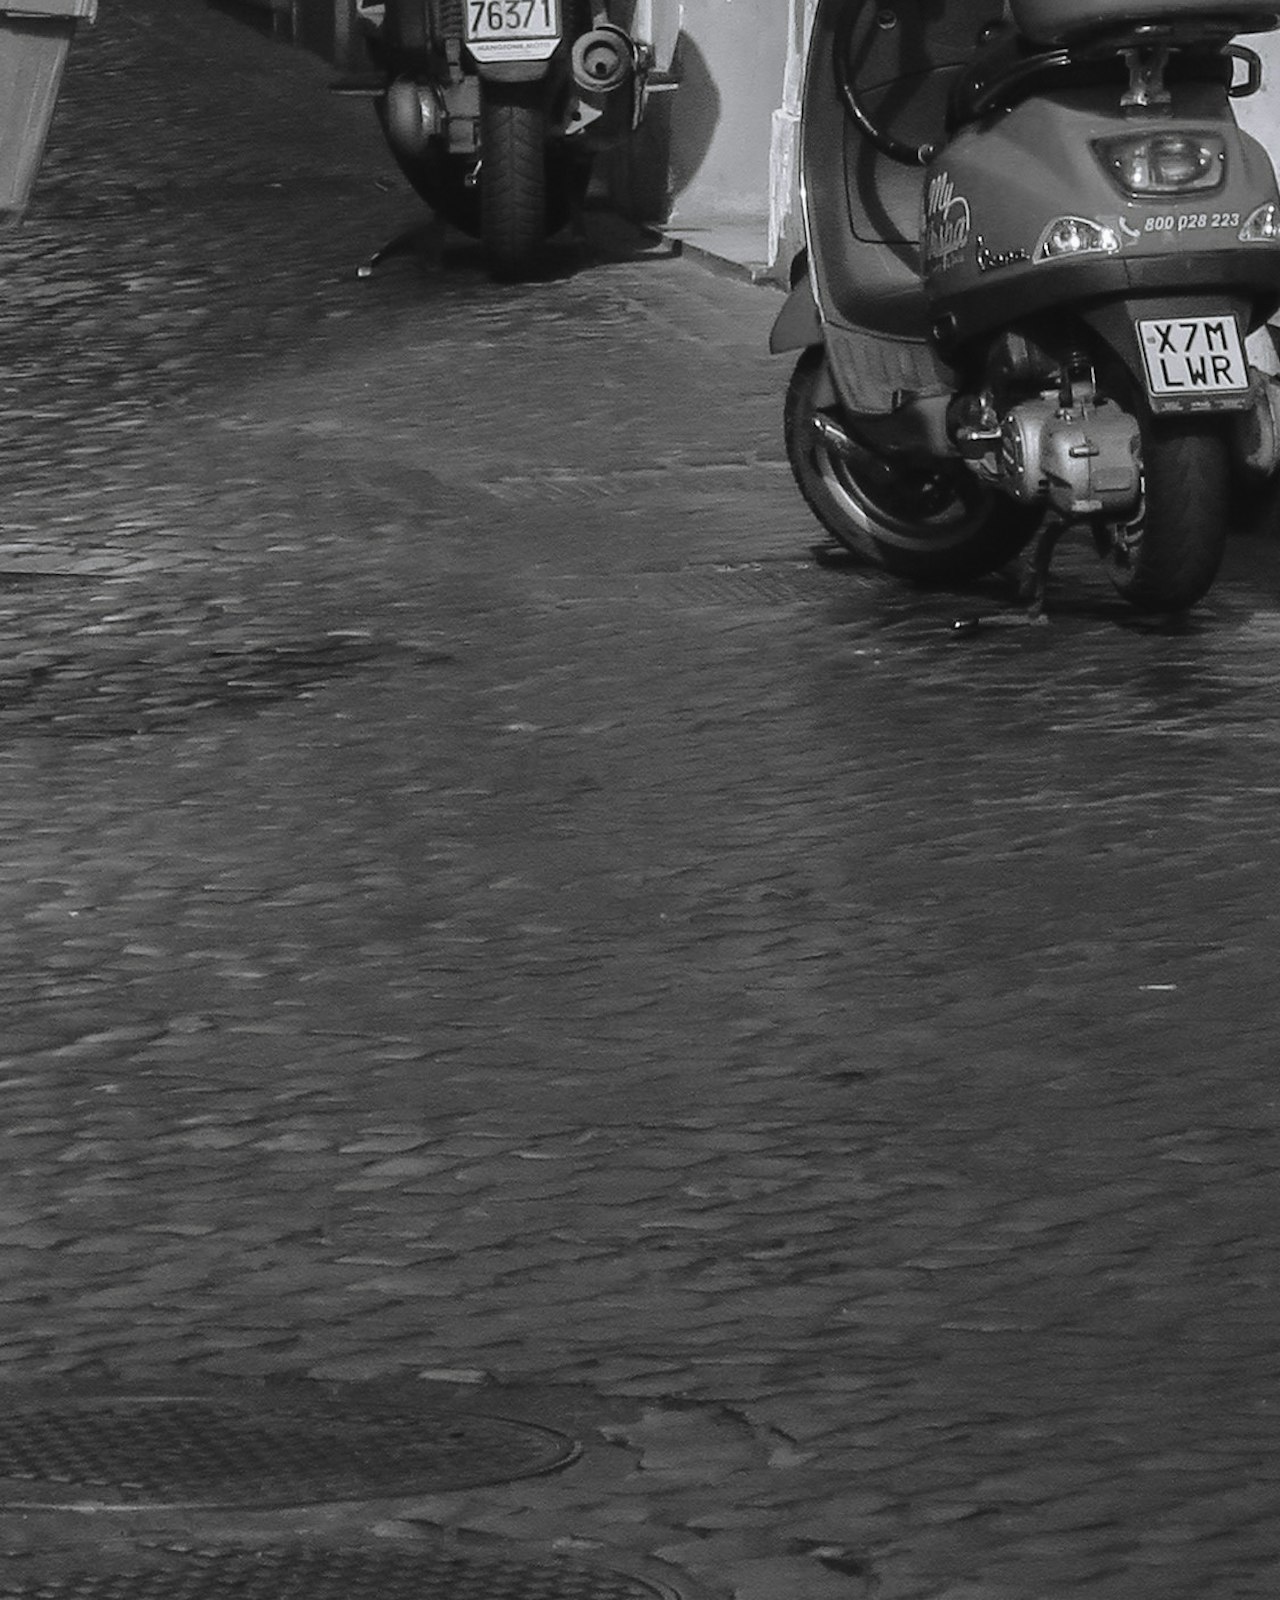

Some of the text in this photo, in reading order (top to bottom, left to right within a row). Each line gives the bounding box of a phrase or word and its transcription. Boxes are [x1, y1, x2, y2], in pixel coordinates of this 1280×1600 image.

[1144, 212, 1240, 232] 800 028 223
[1153, 322, 1228, 354] X7M
[1159, 355, 1234, 387] LWR
